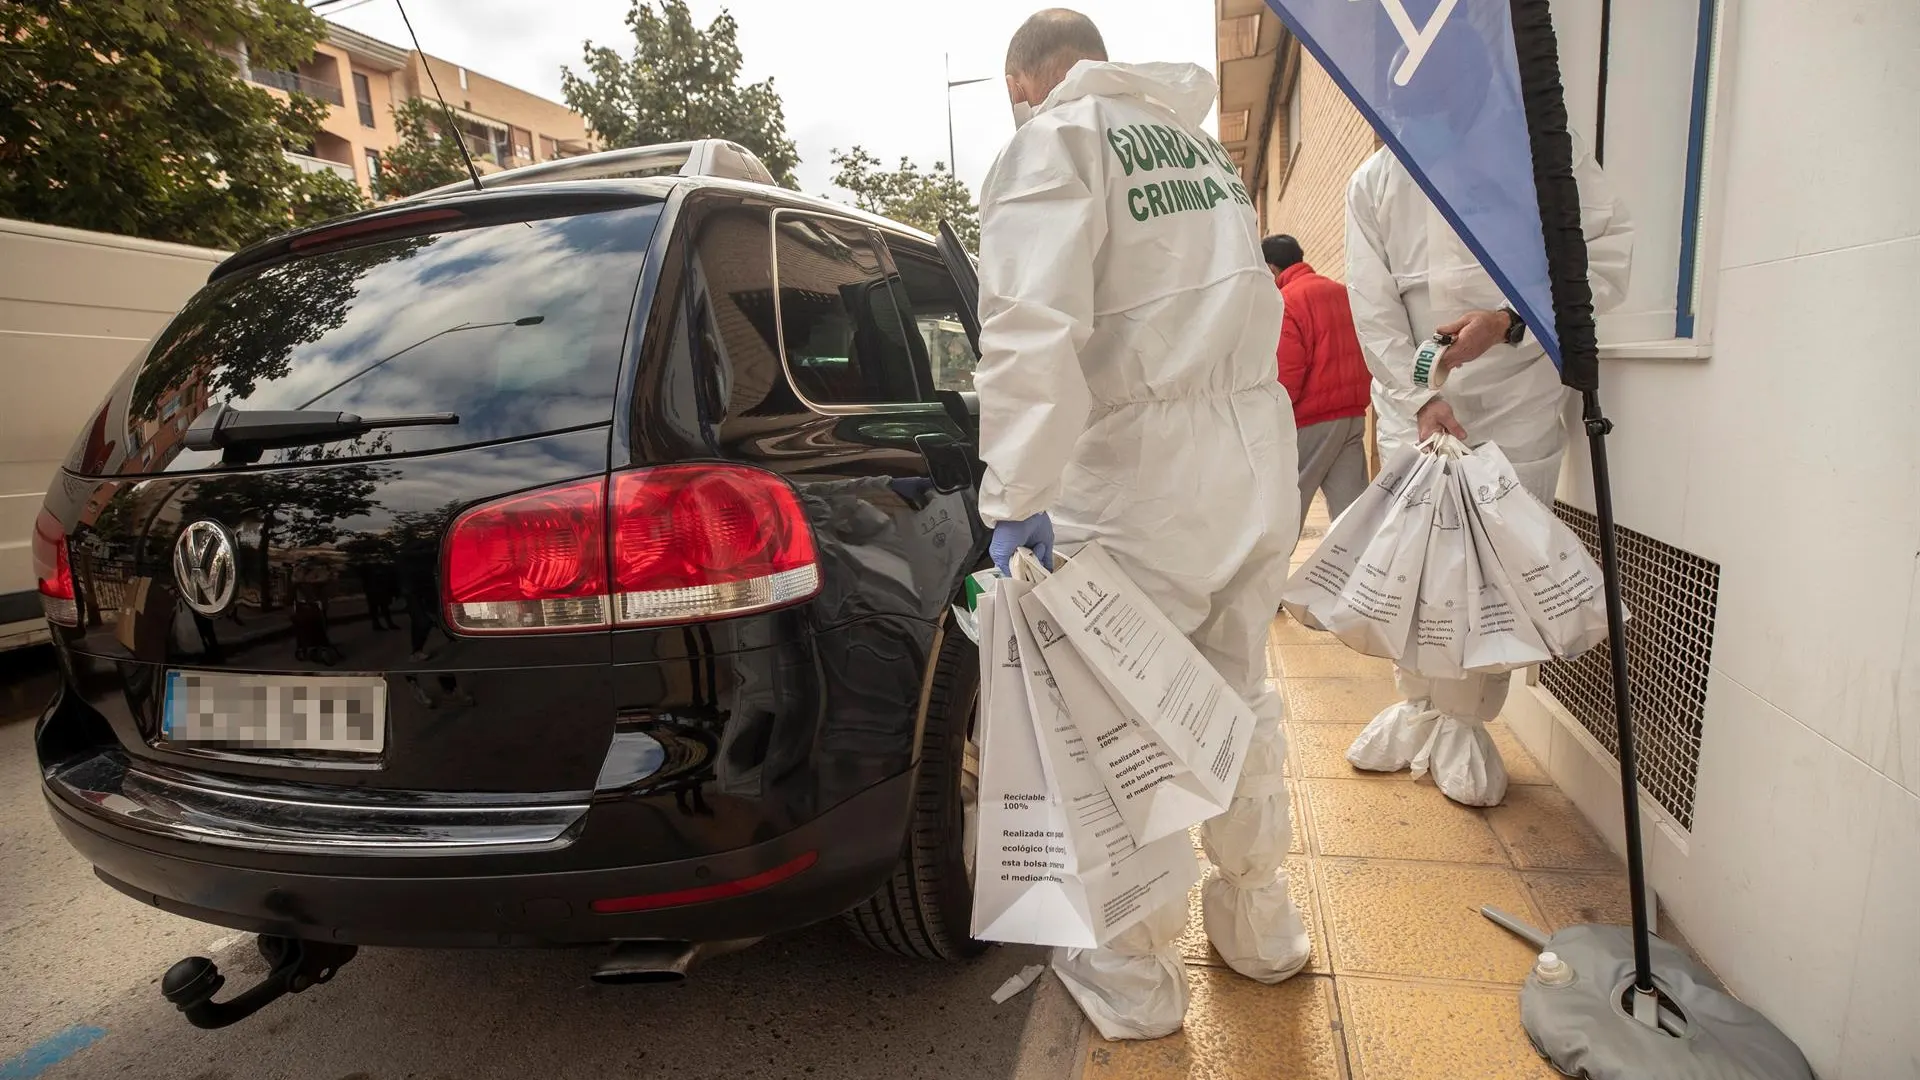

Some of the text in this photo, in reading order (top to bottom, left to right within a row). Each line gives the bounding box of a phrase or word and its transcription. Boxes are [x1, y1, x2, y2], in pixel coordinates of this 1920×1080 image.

[1096, 722, 1128, 742] Reciclable
[1100, 736, 1119, 748] 100%
[1109, 748, 1140, 768] Realizada
[1115, 759, 1145, 779] ecológico
[1121, 778, 1135, 789] esta
[1136, 768, 1154, 781] bolsa
[1003, 793, 1046, 801] Reciclable
[1126, 792, 1133, 800] el
[1003, 802, 1029, 810] 100%
[1002, 829, 1044, 838] Realizada
[1002, 844, 1043, 854] ecológico
[1001, 859, 1021, 867] esta
[1023, 860, 1047, 868] bolsa
[1001, 873, 1009, 881] el
